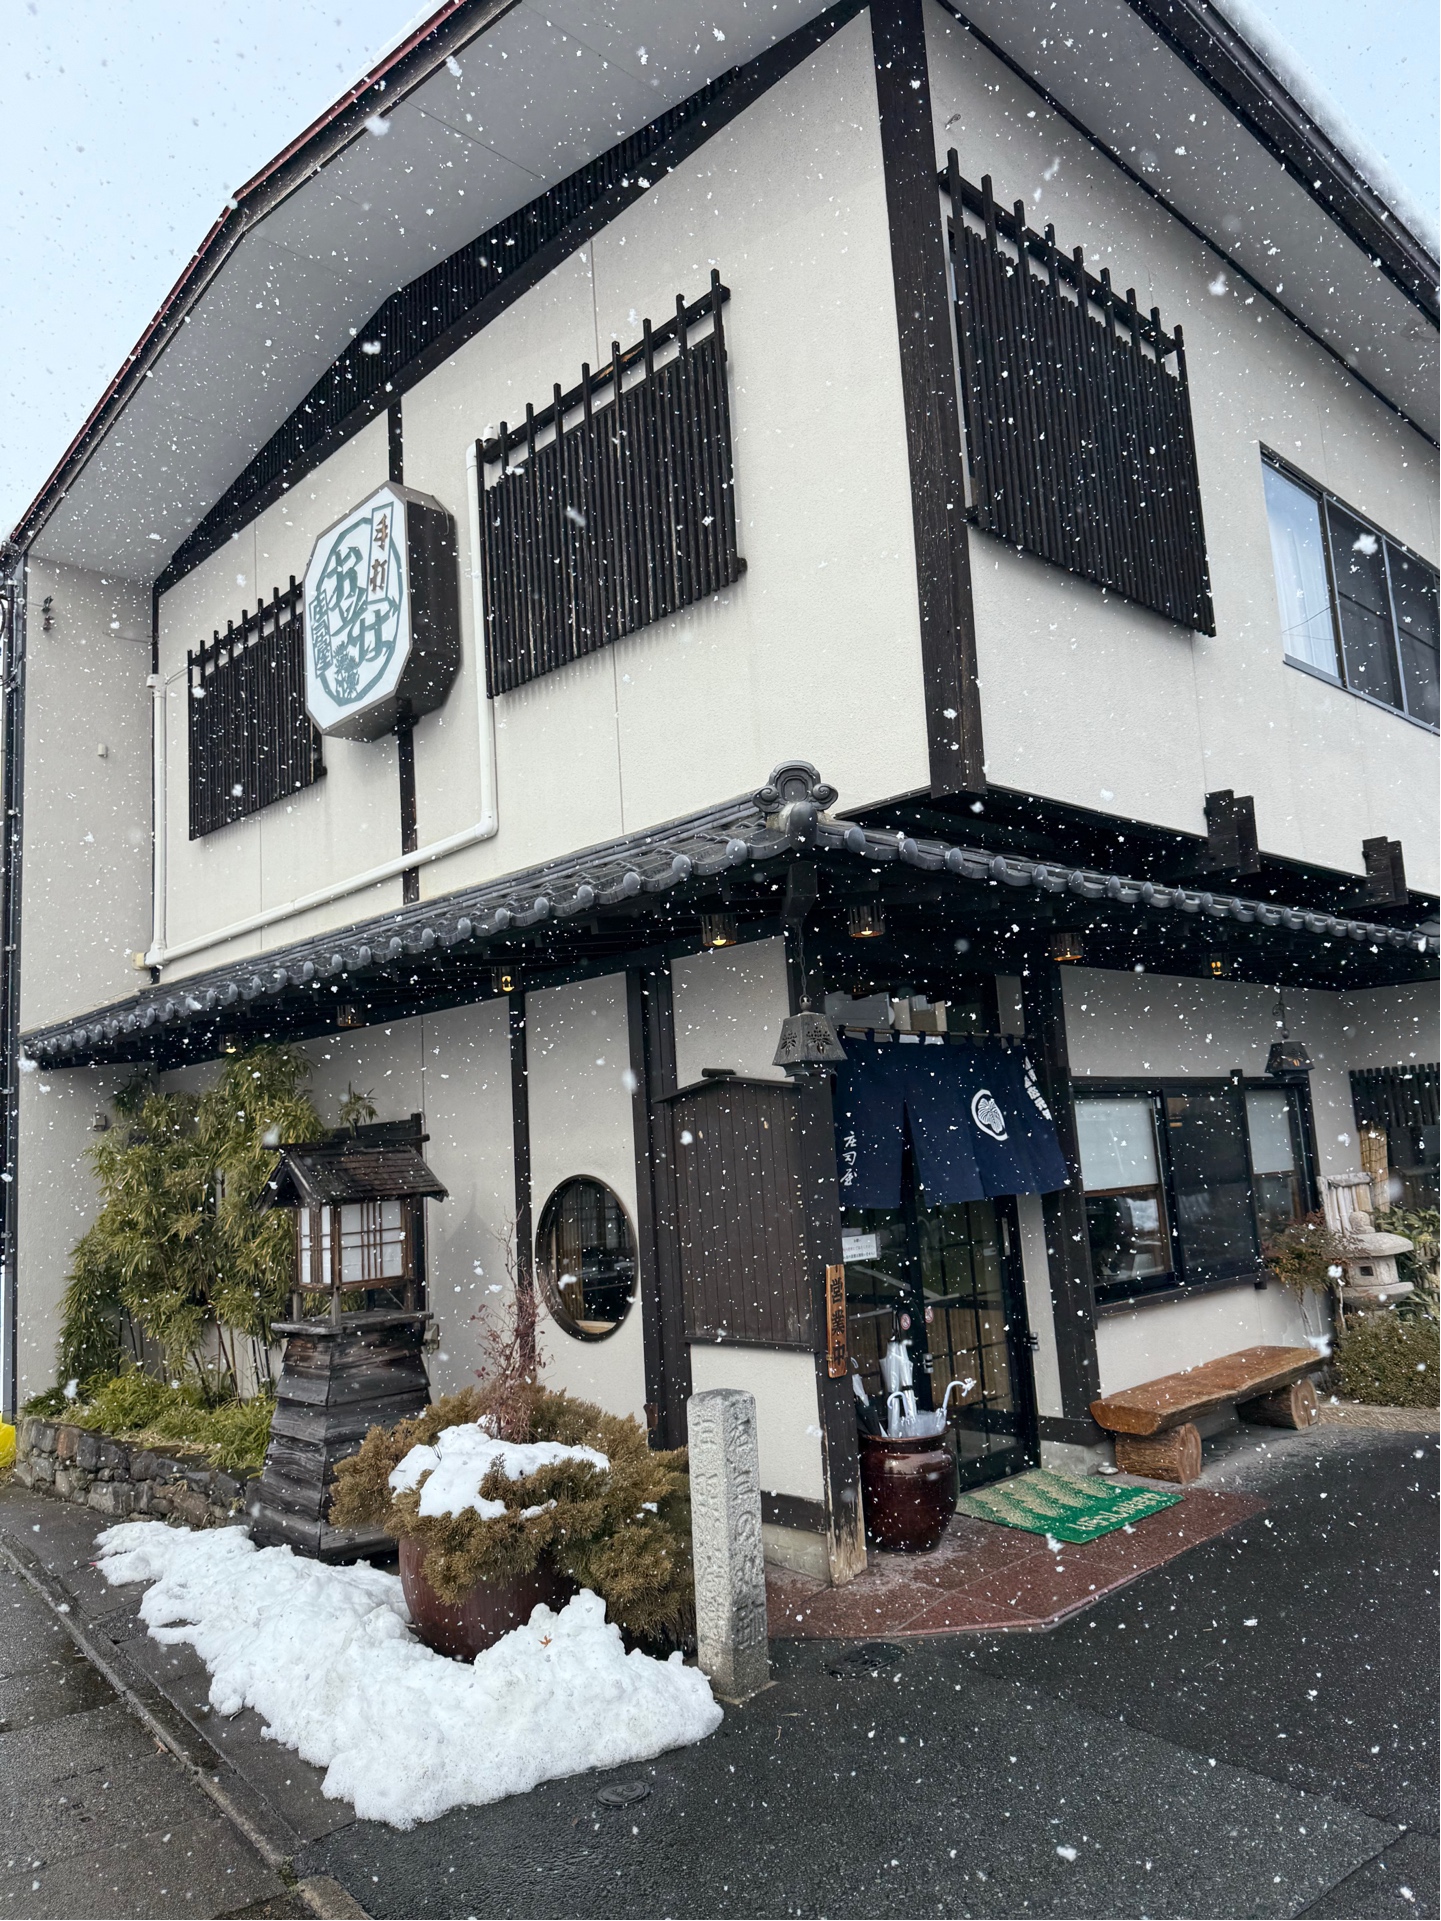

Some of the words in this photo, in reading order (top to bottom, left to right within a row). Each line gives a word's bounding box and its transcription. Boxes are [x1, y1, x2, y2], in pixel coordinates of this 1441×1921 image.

[371, 514, 389, 593] 手打
[839, 1131, 858, 1187] 庄司屋
[830, 1277, 846, 1366] 営業中
